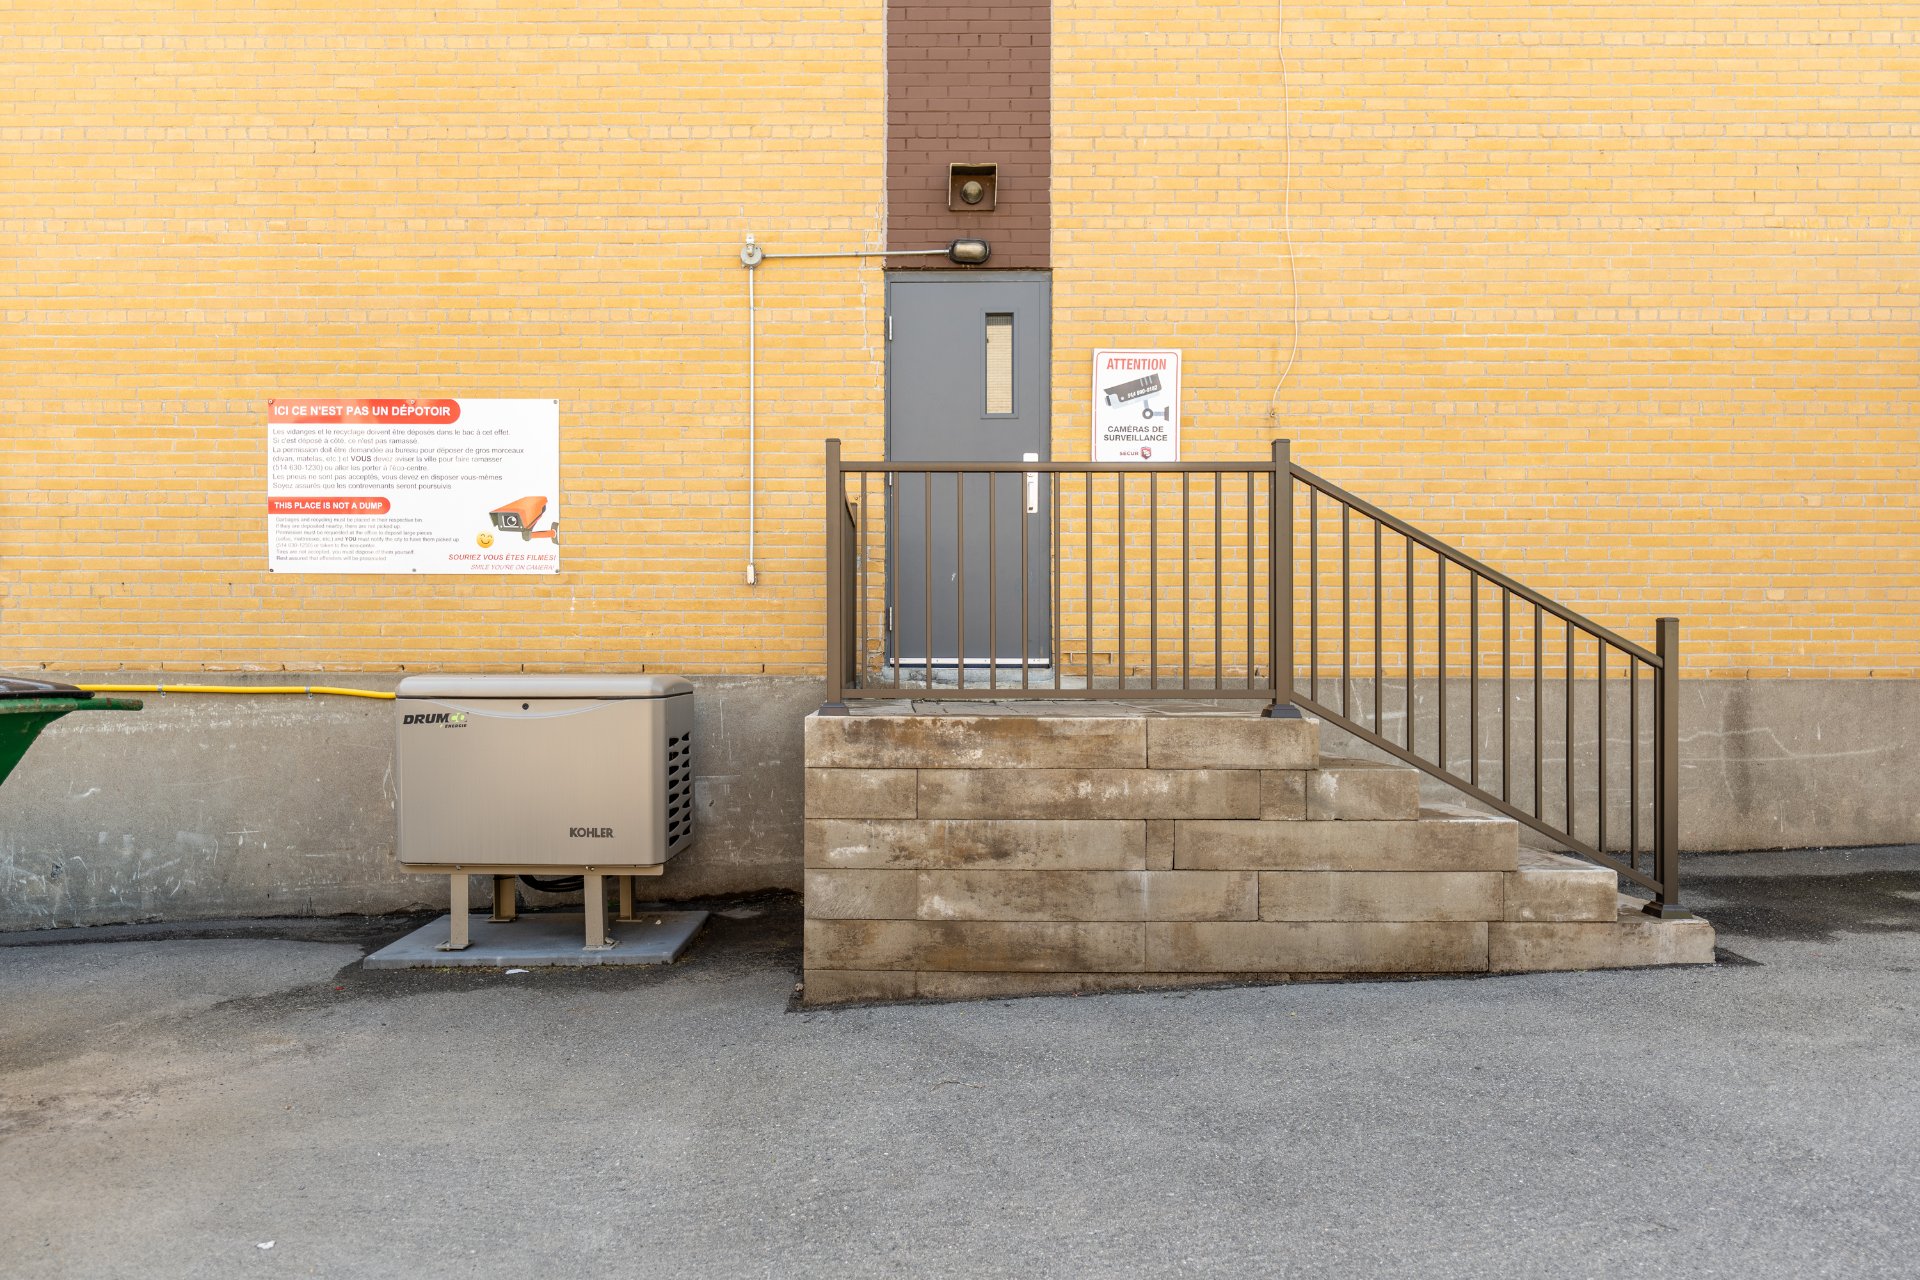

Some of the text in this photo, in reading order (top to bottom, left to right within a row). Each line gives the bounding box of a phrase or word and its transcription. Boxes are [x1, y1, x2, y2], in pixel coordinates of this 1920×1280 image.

[1106, 358, 1167, 370] ATTENTION
[274, 404, 450, 416] ICI CE N'EST PAS UN DÉPOTOIR
[569, 827, 614, 838] KOHLER
